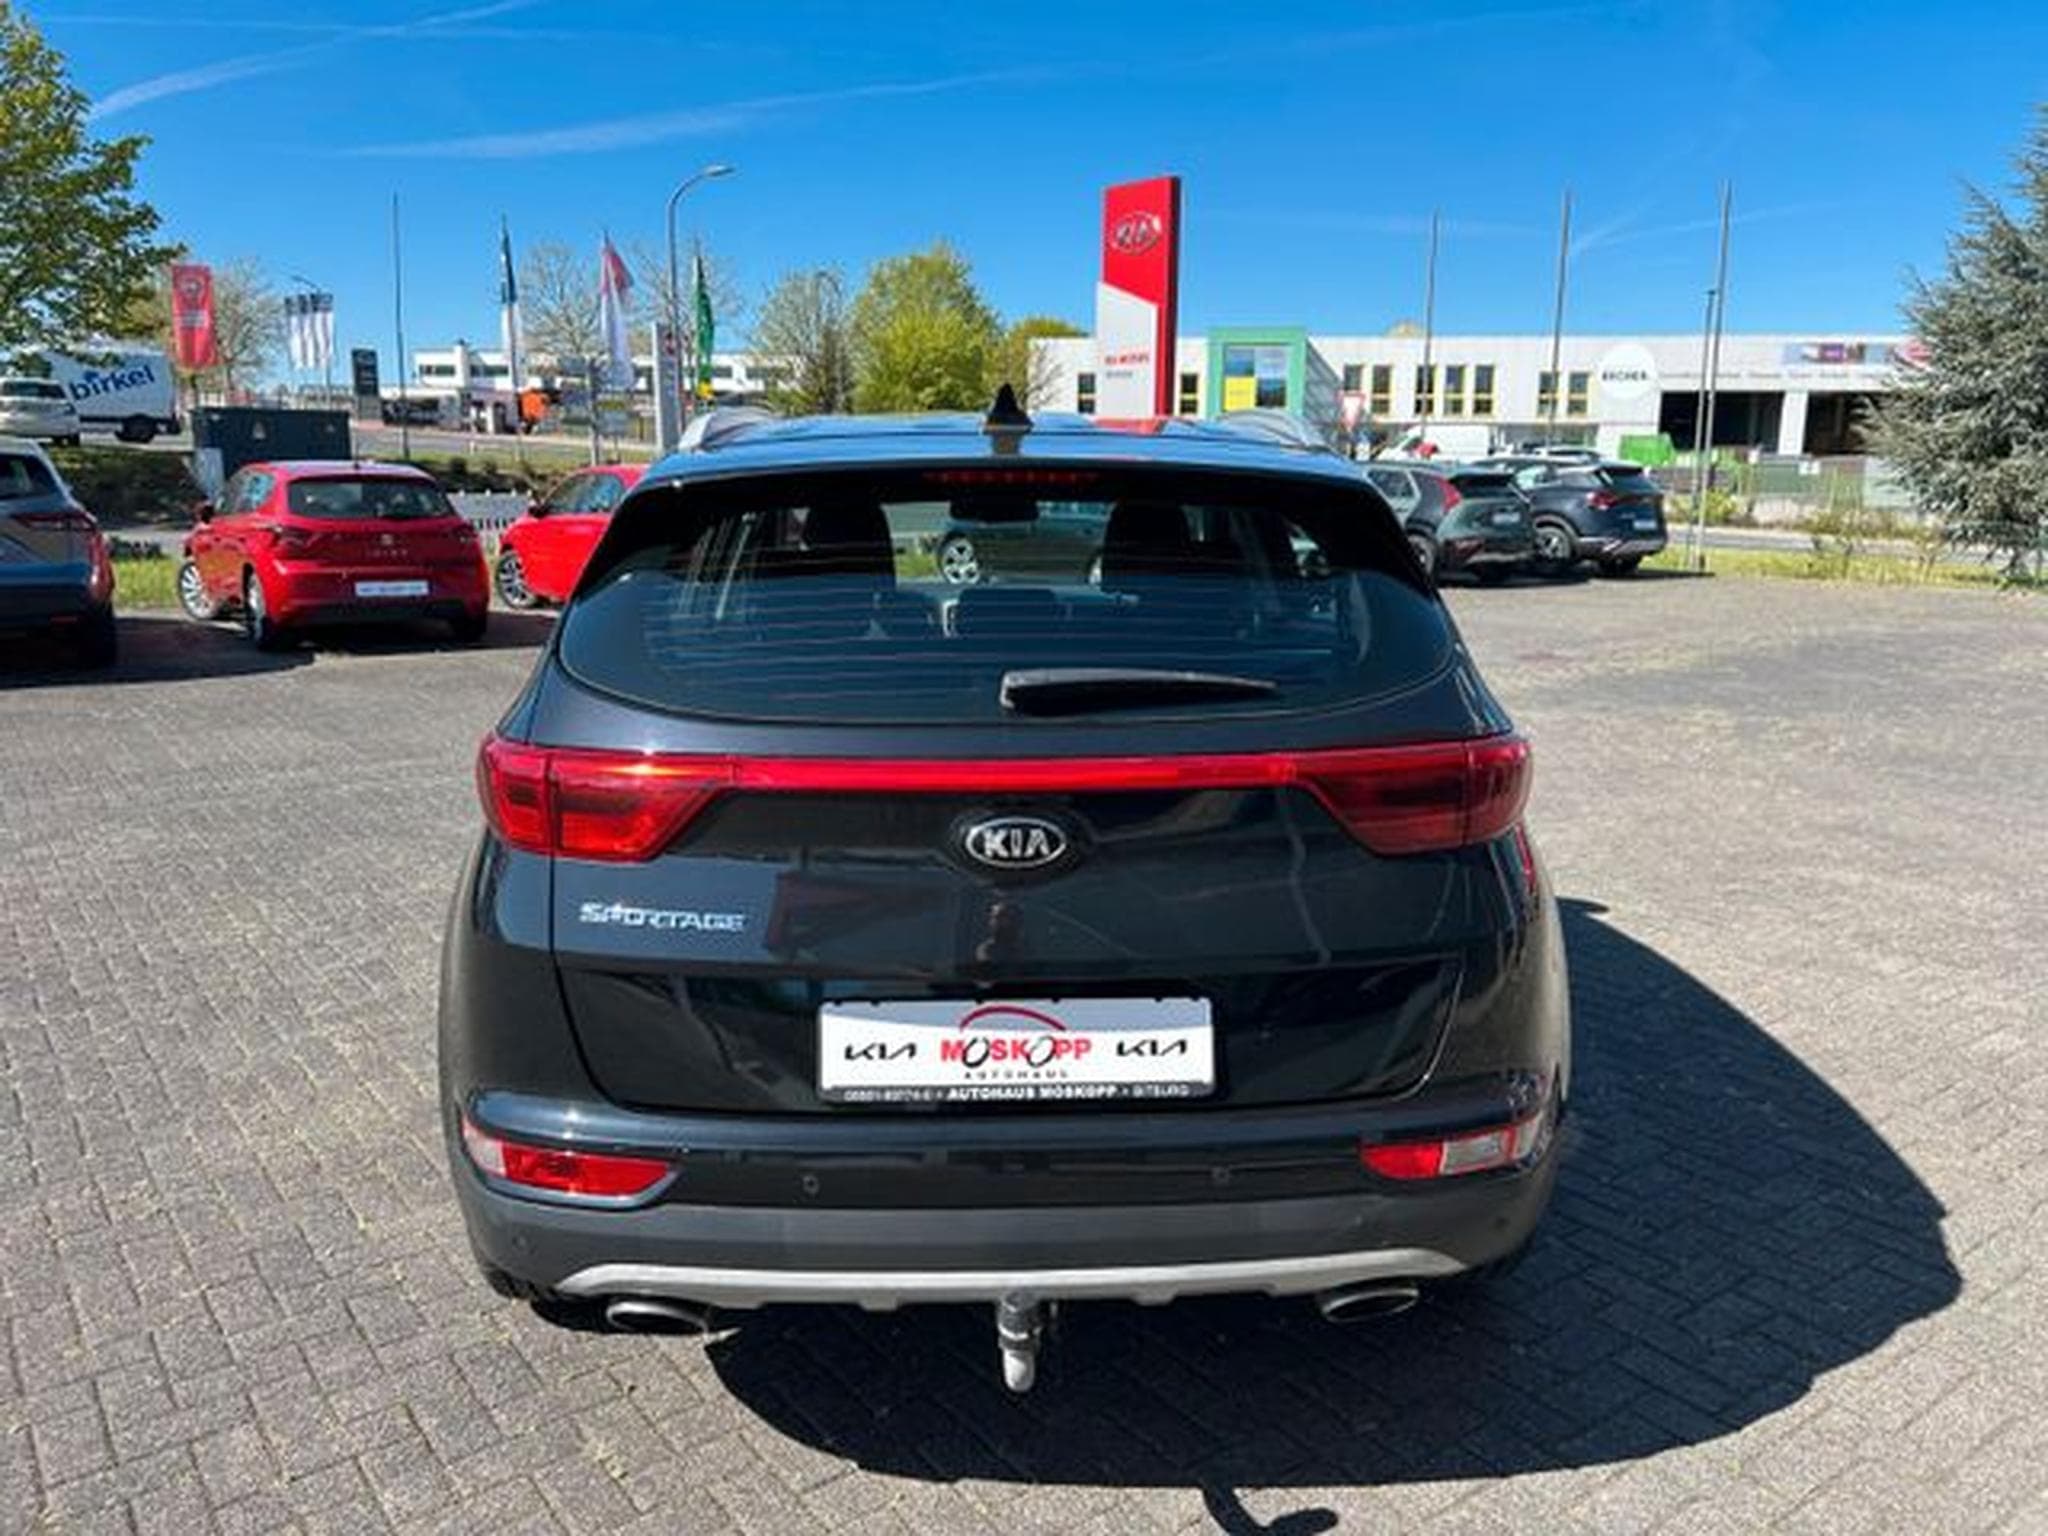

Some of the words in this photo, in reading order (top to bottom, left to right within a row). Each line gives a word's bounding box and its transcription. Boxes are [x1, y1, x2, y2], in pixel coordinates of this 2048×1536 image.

[69, 365, 155, 400] birkel
[983, 828, 1049, 857] KIA
[579, 903, 744, 931] SPORTAGE
[845, 1042, 916, 1061] KIA
[940, 1036, 1092, 1068] MOSKOPP
[1117, 1039, 1186, 1056] KIA
[964, 1070, 1068, 1079] AUTOHAUS
[947, 1085, 1034, 1100] AUTOHAUS
[1039, 1084, 1117, 1099] MOSKOPP
